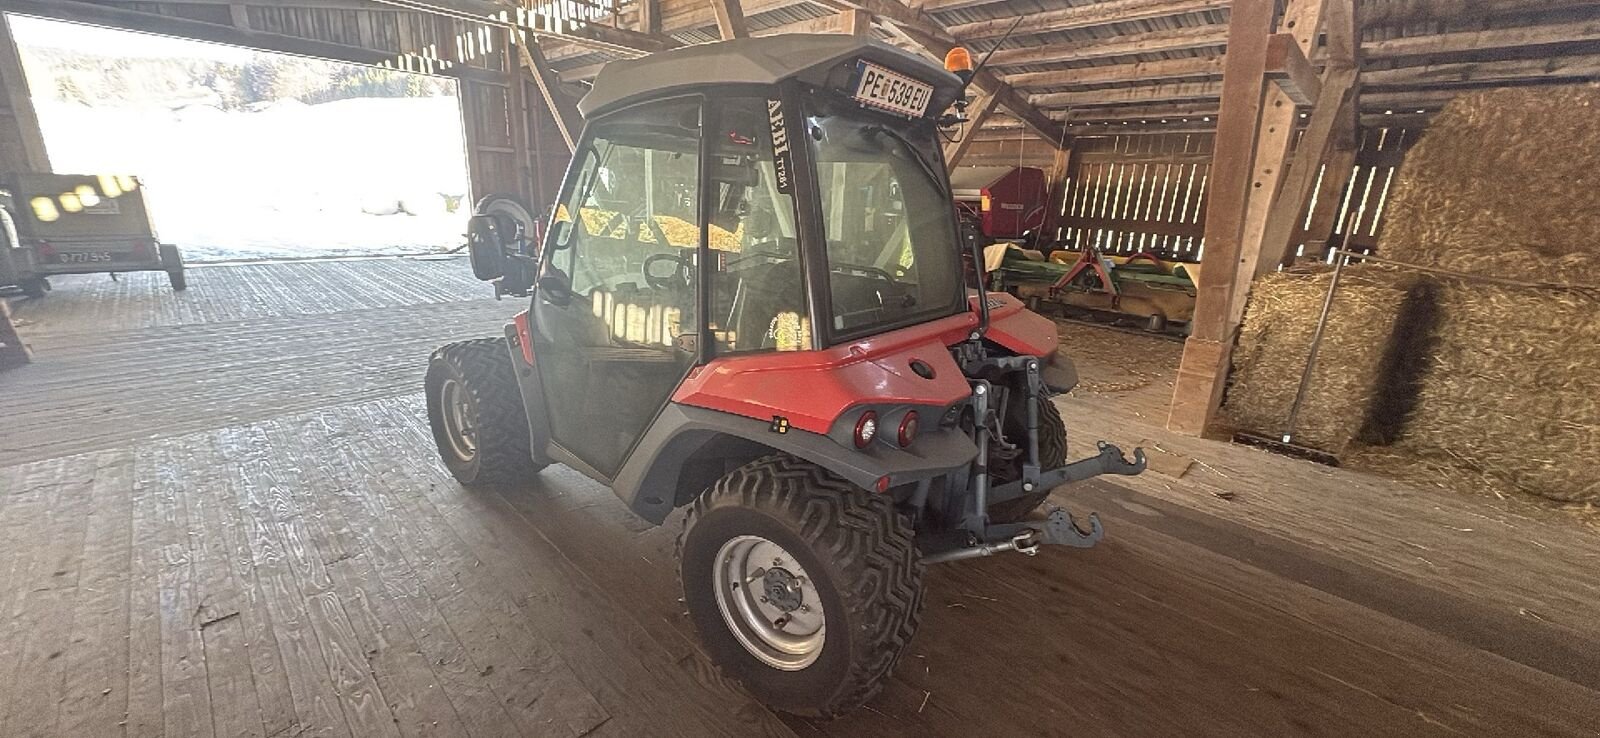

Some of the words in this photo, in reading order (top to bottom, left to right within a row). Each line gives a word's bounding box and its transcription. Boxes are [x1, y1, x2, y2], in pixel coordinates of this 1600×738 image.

[861, 70, 884, 98] PE
[888, 79, 914, 107] 539
[909, 88, 929, 112] EU
[767, 99, 789, 157] AEBI
